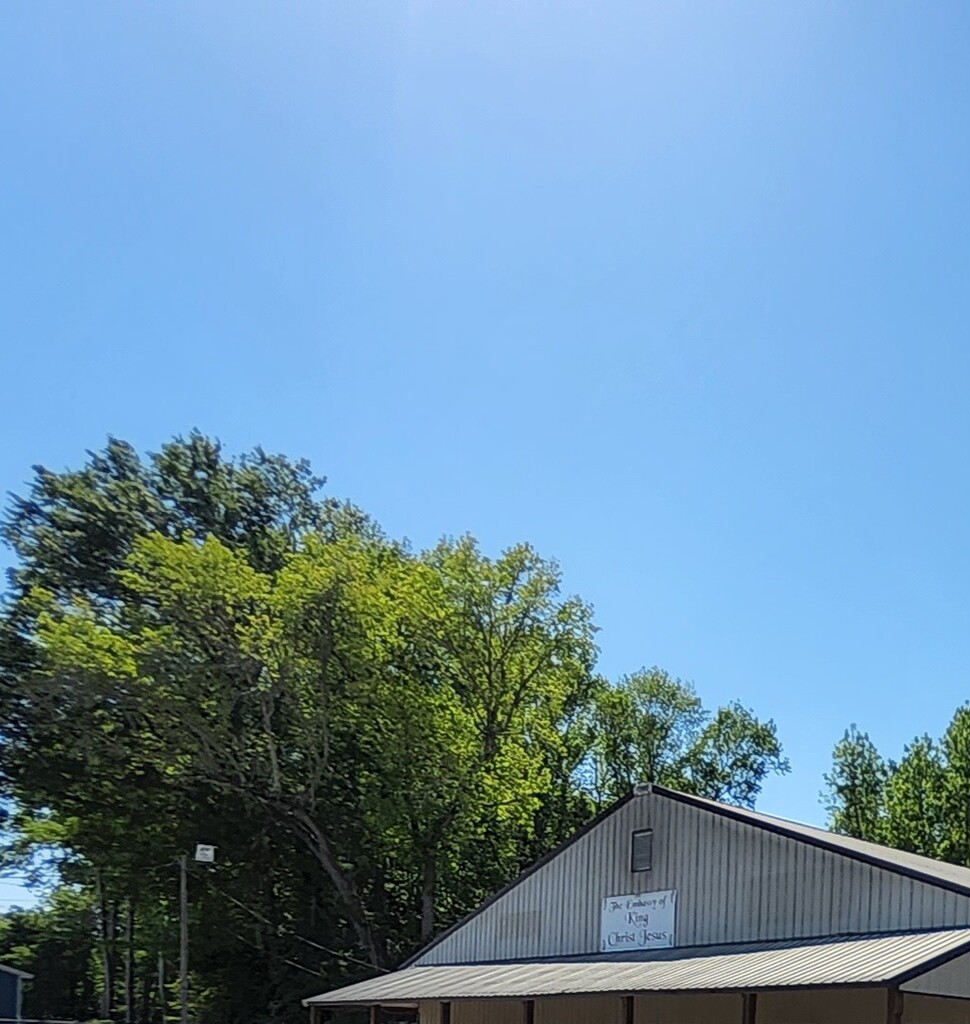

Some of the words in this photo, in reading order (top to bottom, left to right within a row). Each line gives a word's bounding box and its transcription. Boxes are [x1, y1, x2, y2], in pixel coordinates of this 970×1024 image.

[608, 902, 622, 913] The
[658, 896, 667, 909] of
[625, 911, 648, 927] King
[608, 931, 636, 946] Christ
[638, 929, 668, 946] Jesus
